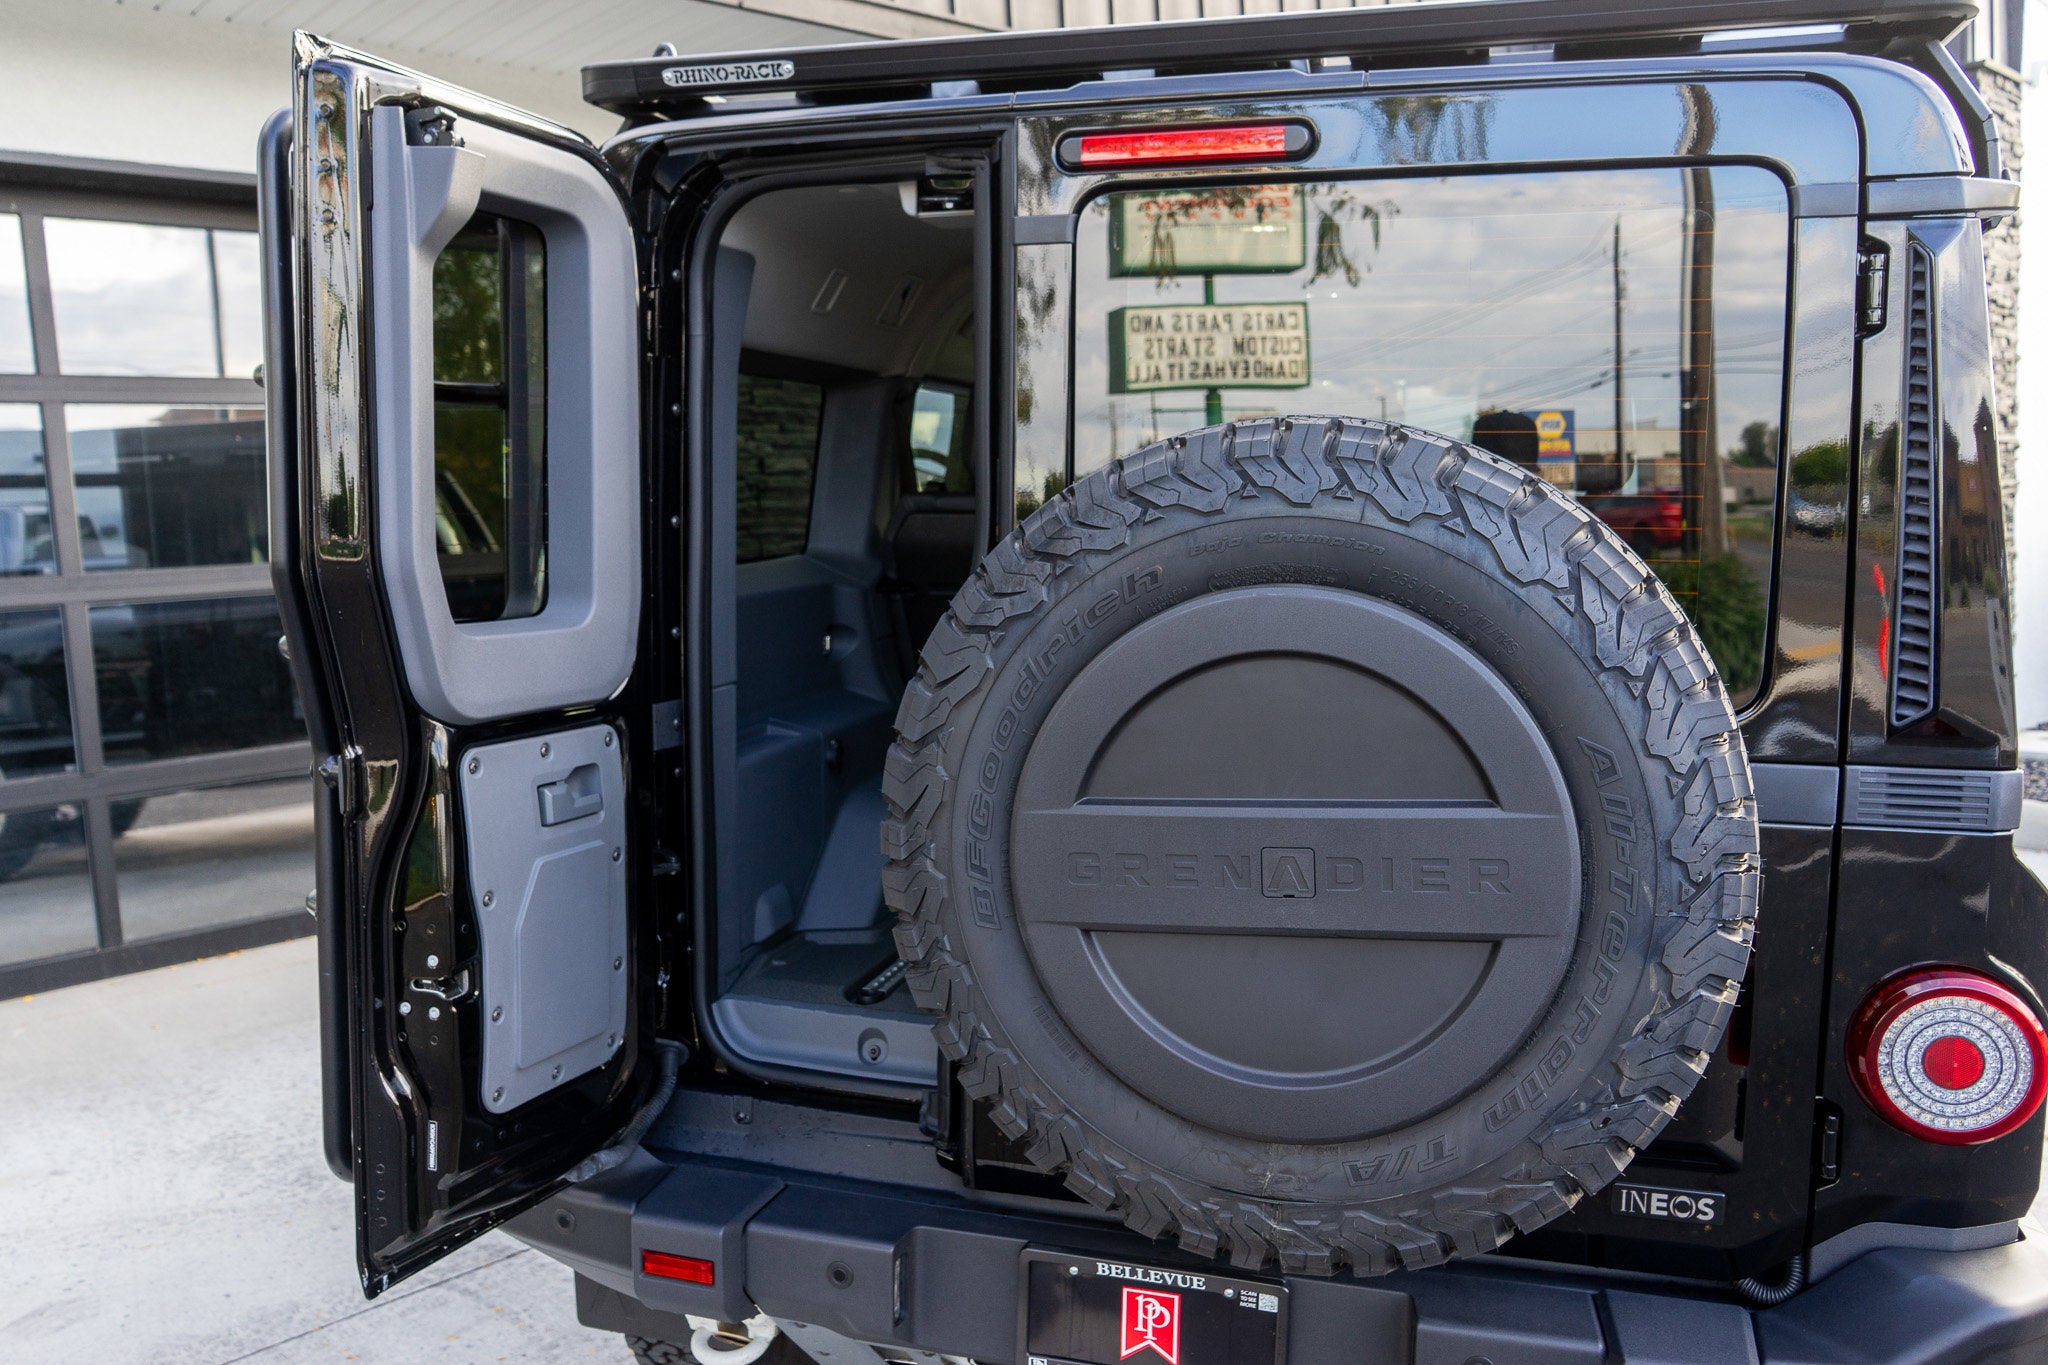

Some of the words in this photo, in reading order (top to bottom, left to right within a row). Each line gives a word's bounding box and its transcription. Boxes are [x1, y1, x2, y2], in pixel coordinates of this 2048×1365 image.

[673, 63, 783, 84] RHINO-RACK
[1257, 531, 1385, 556] Champion
[966, 565, 1163, 930] BFGoodrich
[1067, 851, 1512, 895] GRENADIER
[1342, 1133, 1459, 1187] T/A
[1621, 1189, 1715, 1221] INEOS
[1096, 1262, 1206, 1290] BELLEVUE
